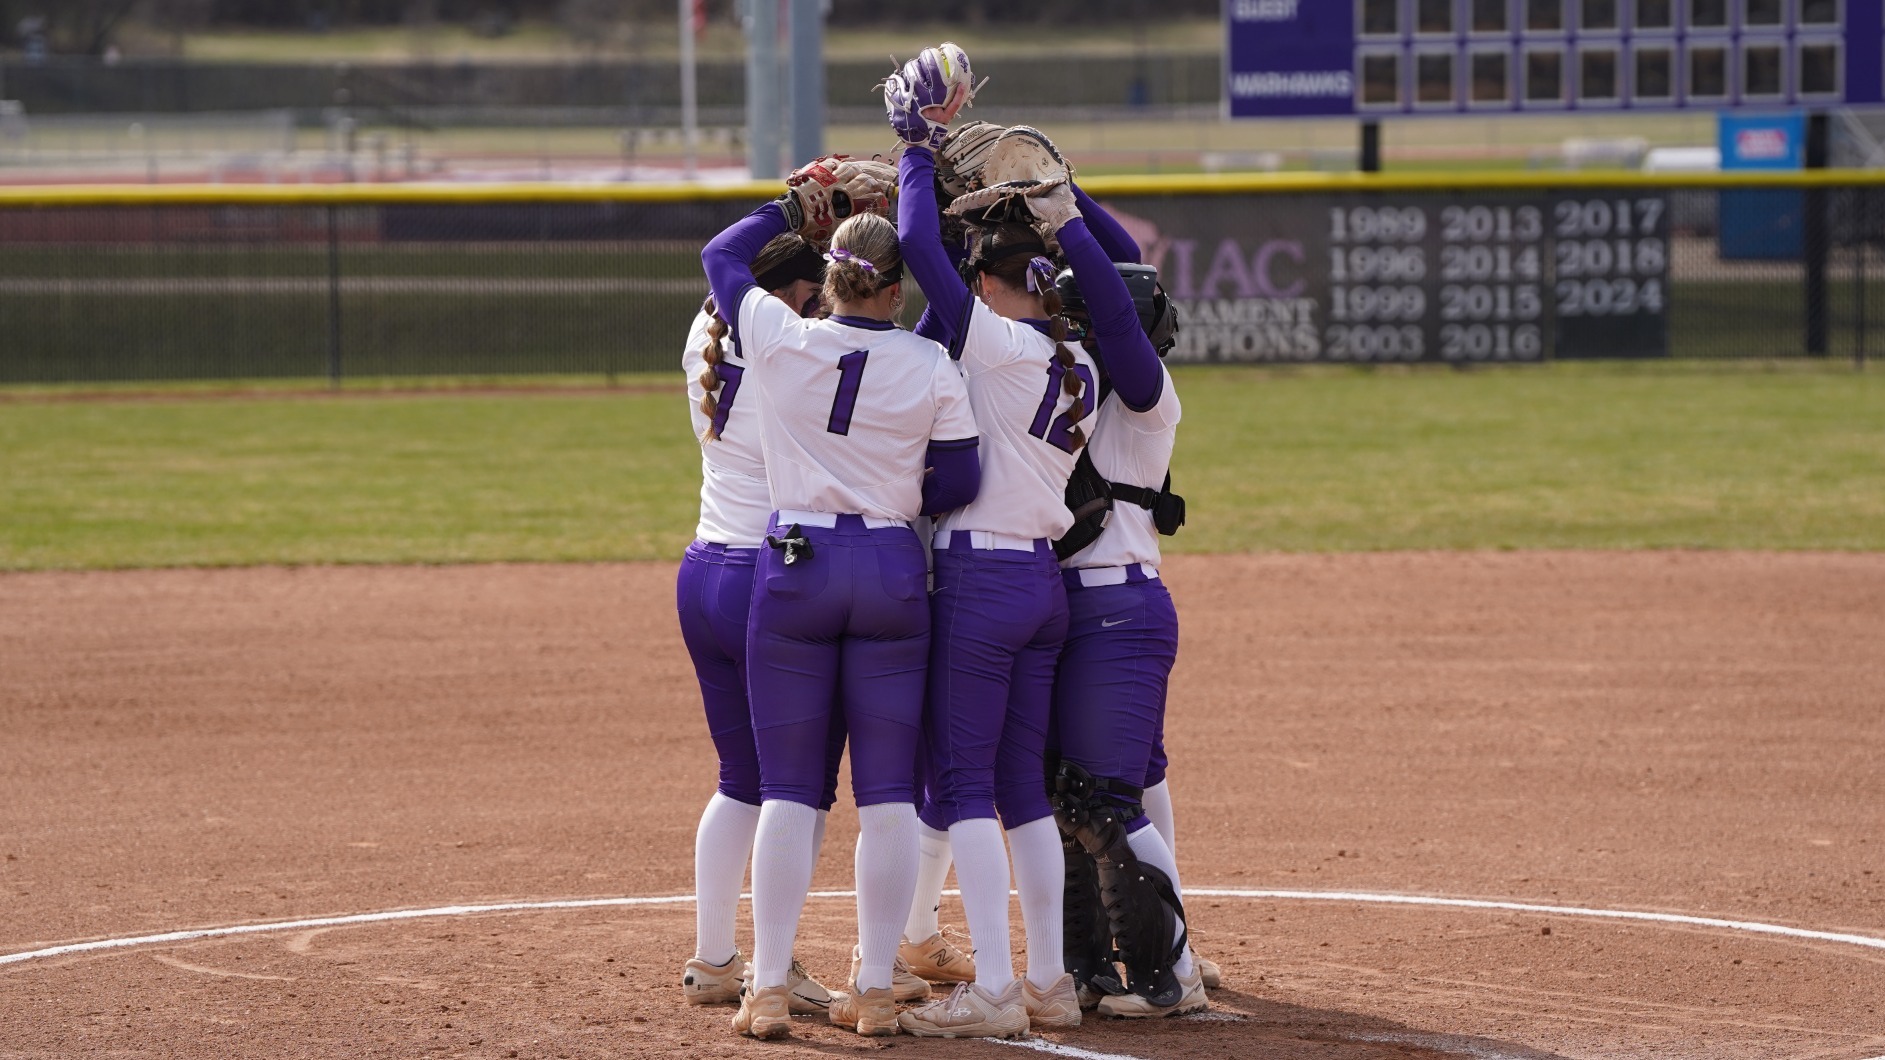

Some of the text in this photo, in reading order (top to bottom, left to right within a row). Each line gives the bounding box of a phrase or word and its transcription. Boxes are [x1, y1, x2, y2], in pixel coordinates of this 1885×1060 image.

[1233, 72, 1351, 97] WARHAWKS
[1329, 205, 1543, 242] 1989 2013
[1554, 198, 1664, 237] 2017
[1329, 245, 1542, 282] 1996 2014
[1554, 237, 1664, 276] 2018
[1329, 284, 1542, 321] 1999 2015
[1554, 278, 1663, 316] 2024
[1325, 323, 1542, 361] 2003 2016
[712, 361, 745, 441] 7
[827, 350, 869, 436] 1
[1028, 354, 1095, 455] 12
